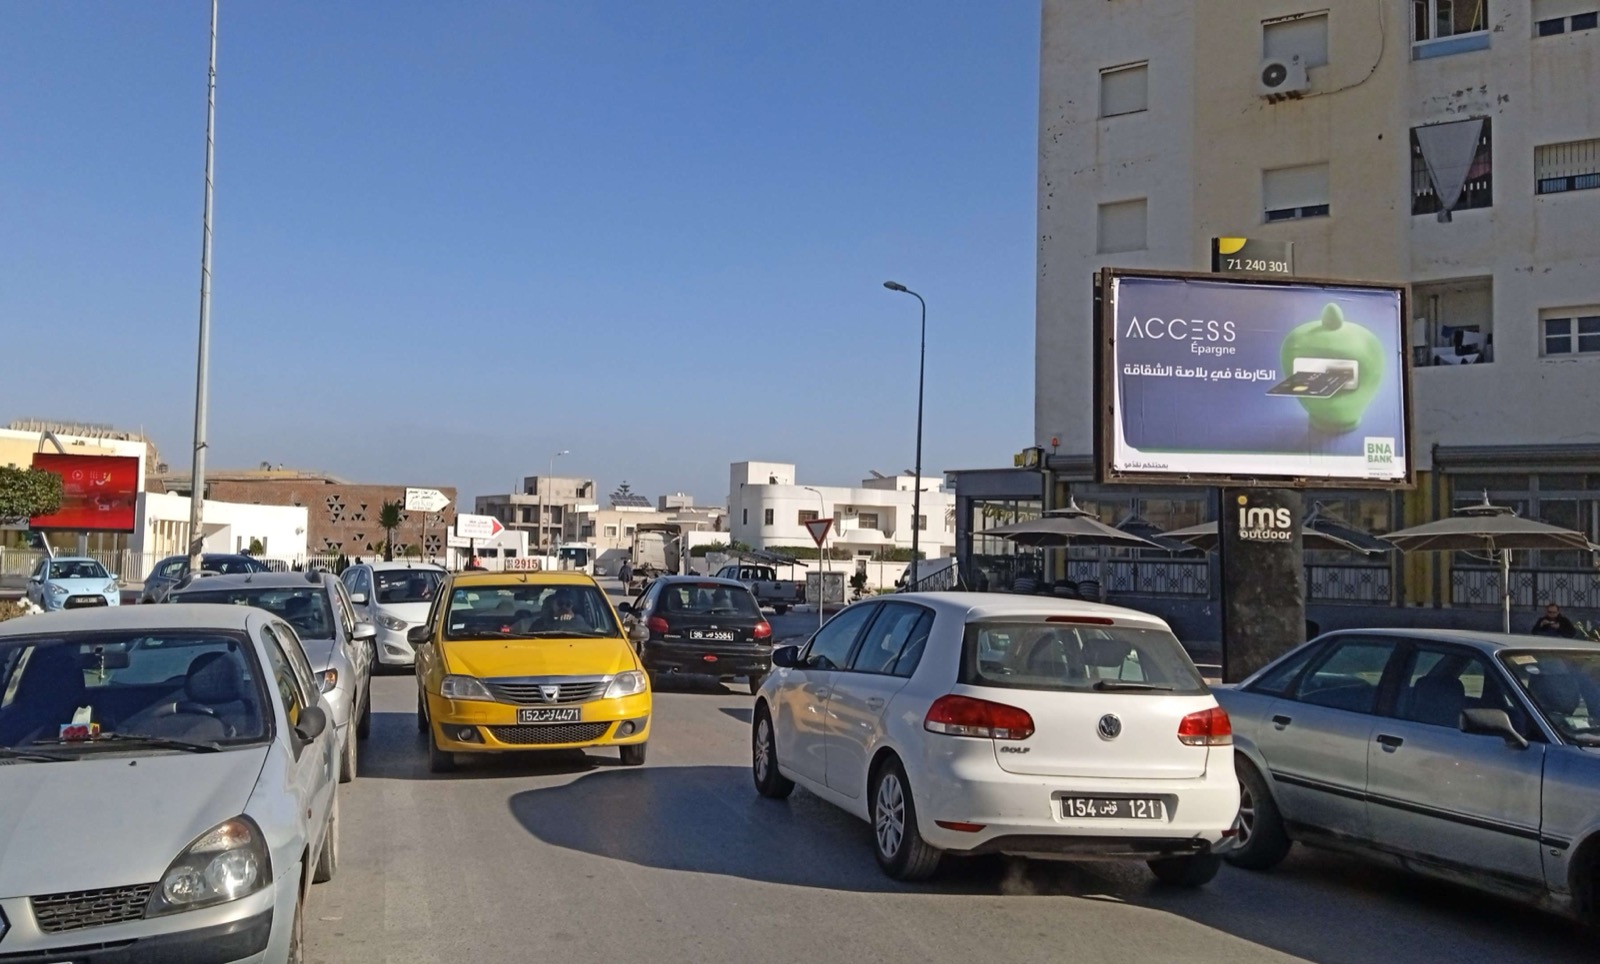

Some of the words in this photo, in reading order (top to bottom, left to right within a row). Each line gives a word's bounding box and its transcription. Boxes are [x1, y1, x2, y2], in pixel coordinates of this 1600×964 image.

[1226, 258, 1242, 270] 71
[1245, 259, 1267, 271] 240
[1268, 261, 1288, 273] 301
[1125, 315, 1236, 342] ACCESS
[1191, 341, 1236, 357] Épargne
[1123, 362, 1173, 377] الشقاقة
[1175, 366, 1208, 381] بلاصة
[1210, 368, 1232, 381] في
[1234, 369, 1276, 382] الكارطة
[1367, 443, 1392, 454] BNA
[1367, 454, 1393, 463] BANK
[1237, 495, 1292, 529] ims
[1239, 529, 1292, 540] outdoor
[514, 558, 538, 569] 2915
[522, 710, 539, 721] 152
[555, 709, 579, 721] 4471
[1000, 746, 1031, 754] GOLF
[1067, 798, 1097, 817] 154
[1128, 799, 1156, 818] 121
